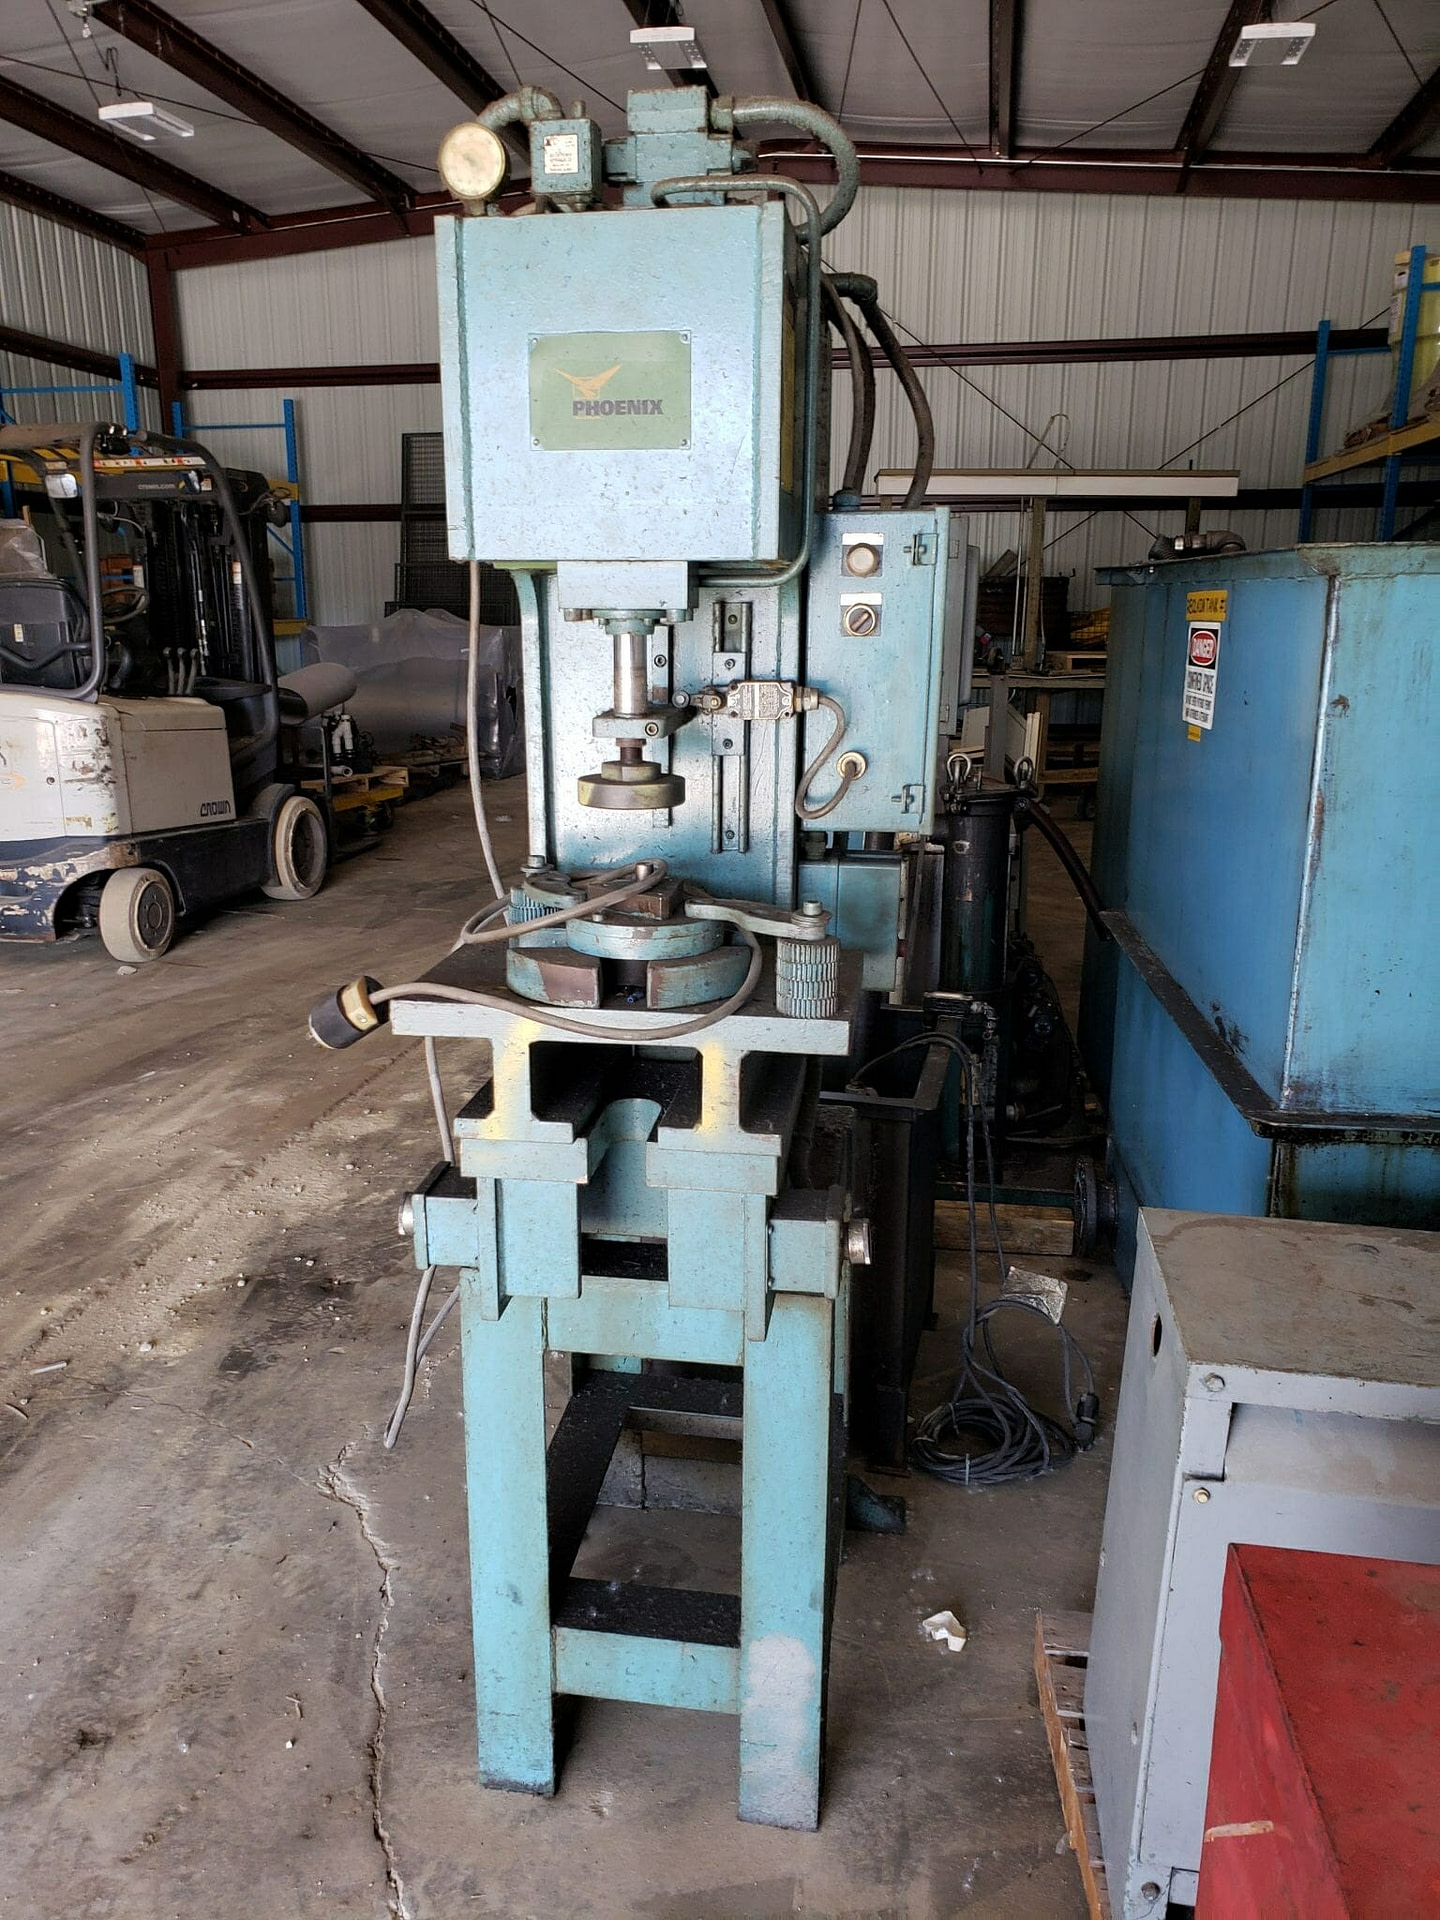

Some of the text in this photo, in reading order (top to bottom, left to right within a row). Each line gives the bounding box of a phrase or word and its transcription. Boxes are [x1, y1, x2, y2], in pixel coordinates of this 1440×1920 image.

[573, 399, 664, 416] PHOENIX
[1191, 638, 1214, 659] DANGER
[200, 800, 231, 817] CROWN
